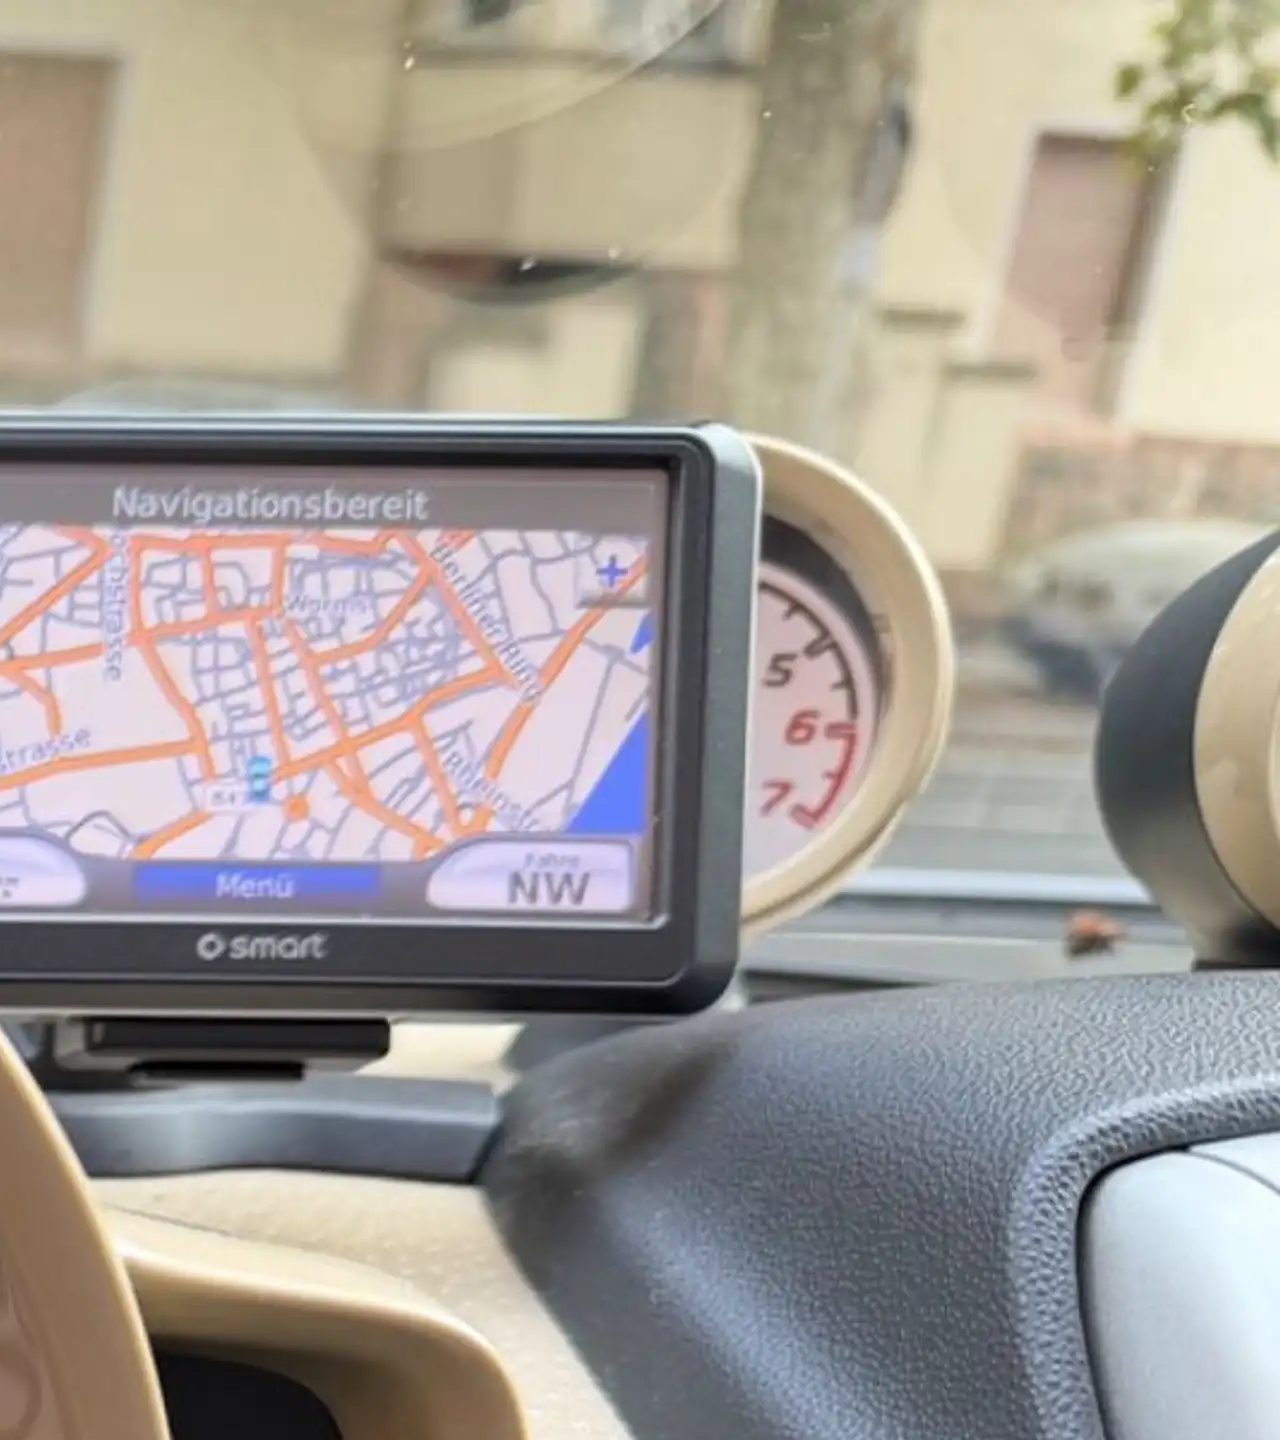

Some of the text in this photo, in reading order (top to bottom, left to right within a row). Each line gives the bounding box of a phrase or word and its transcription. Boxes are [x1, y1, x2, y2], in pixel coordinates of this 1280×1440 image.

[112, 486, 429, 523] Navigationsbereit
[763, 652, 798, 687] 5
[784, 710, 820, 745] 6
[759, 780, 795, 817] 7
[216, 871, 295, 898] Menü
[508, 871, 590, 905] NW
[229, 933, 328, 960] smart
